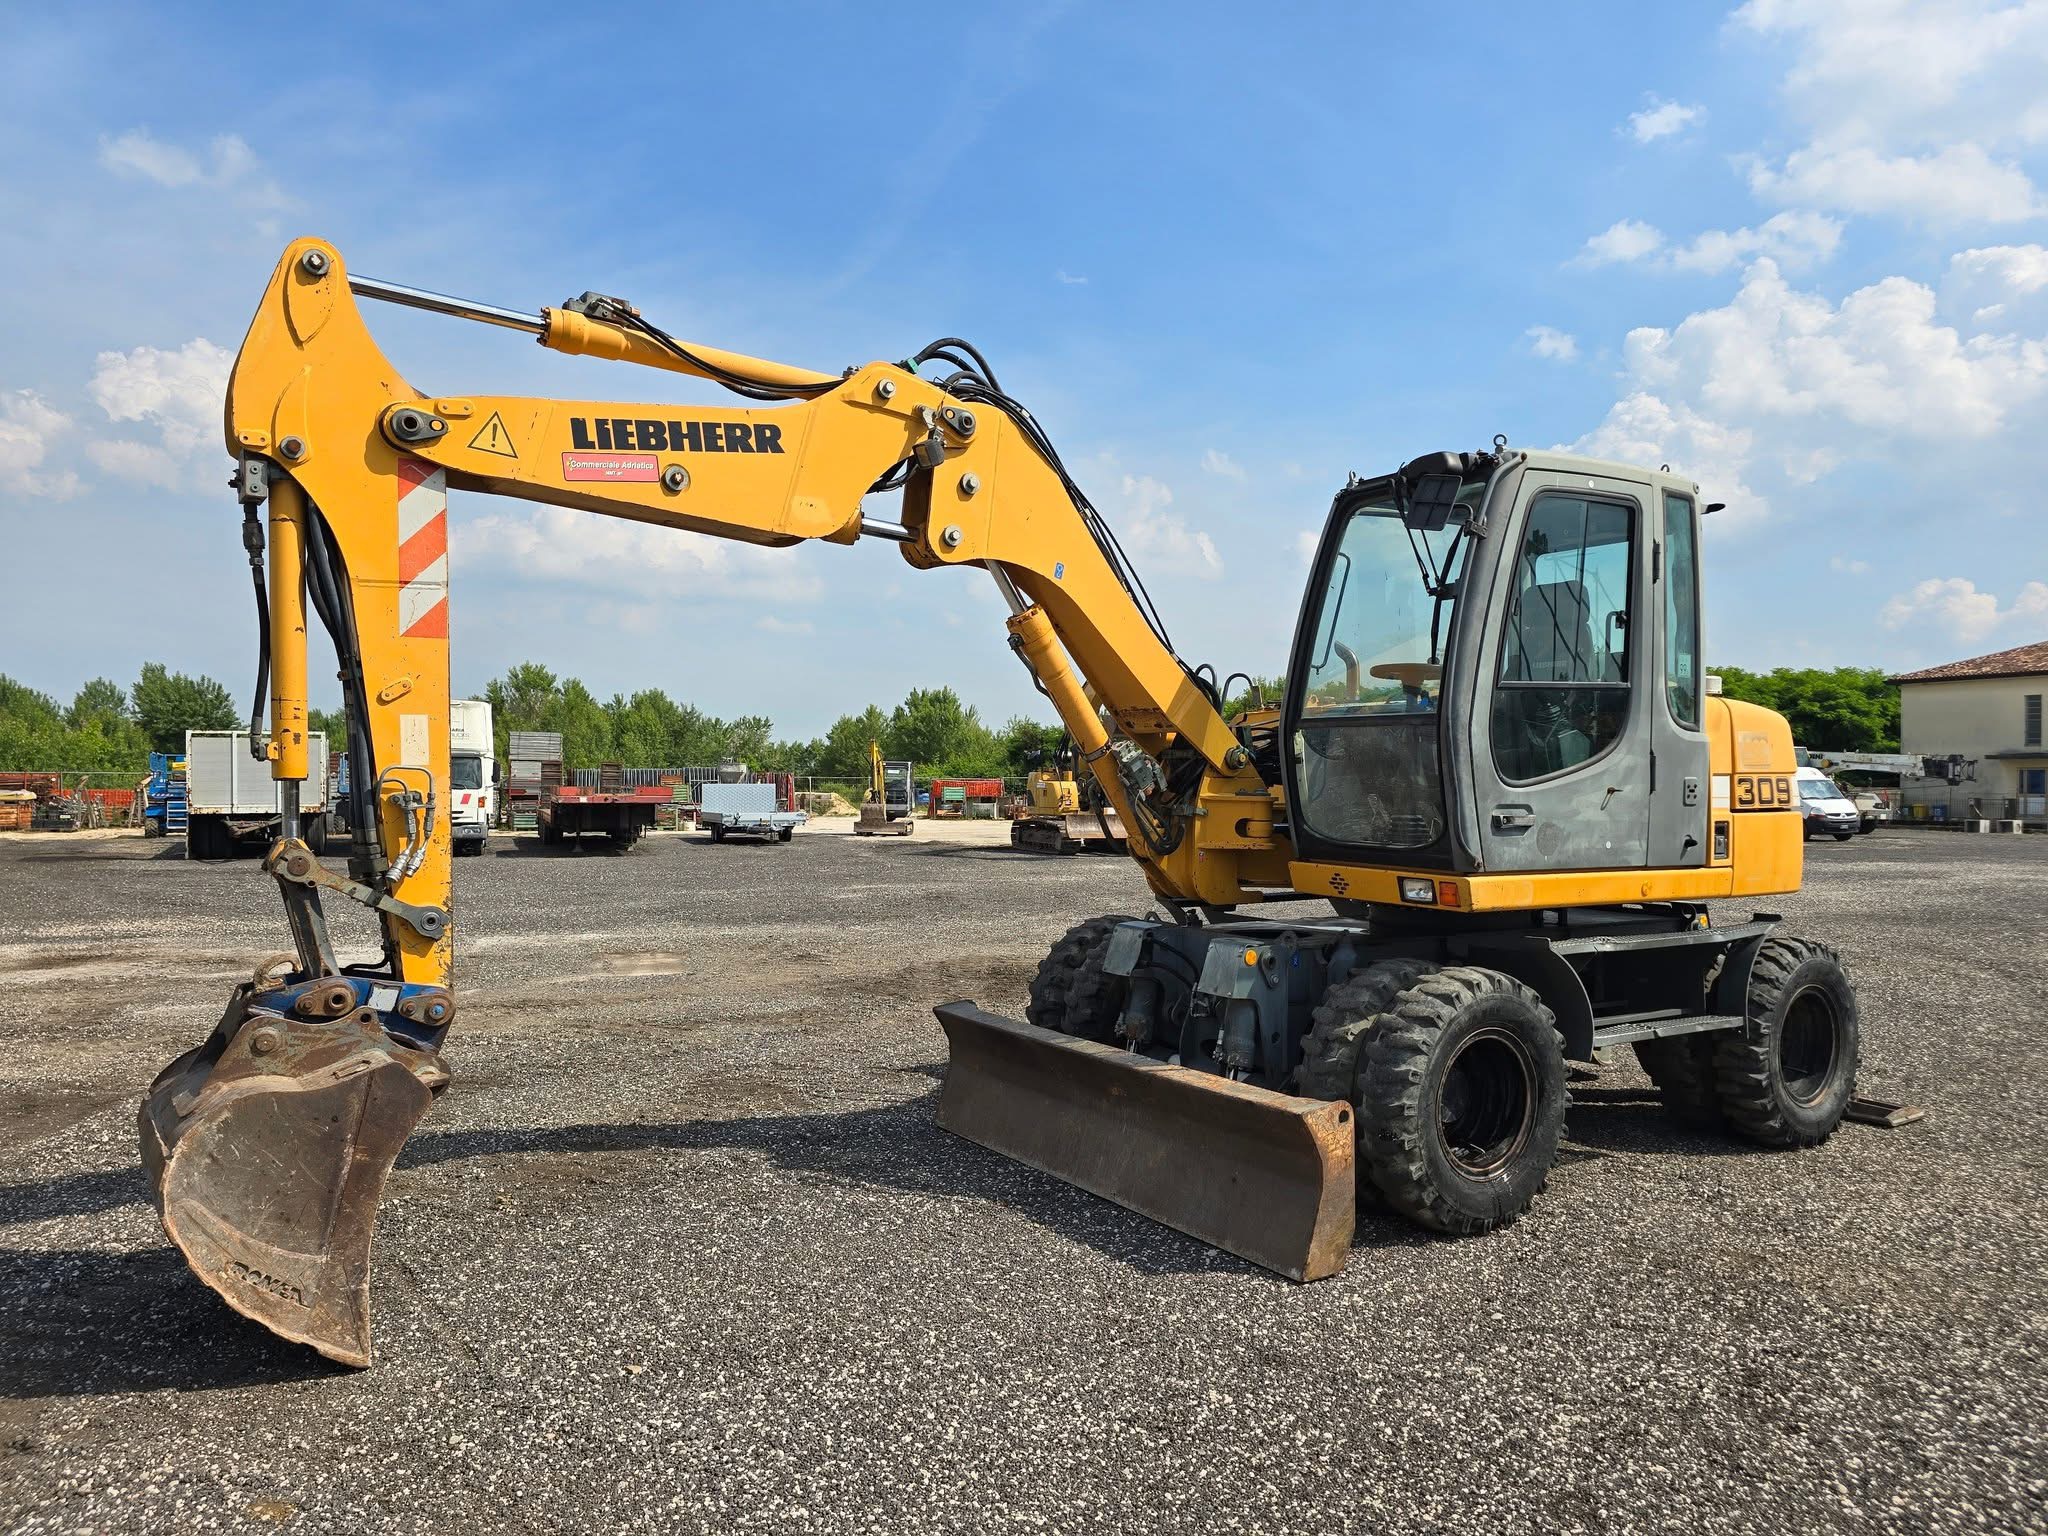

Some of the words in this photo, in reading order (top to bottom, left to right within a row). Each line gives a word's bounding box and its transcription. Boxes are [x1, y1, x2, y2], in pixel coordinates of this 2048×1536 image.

[570, 417, 785, 453] LIEBHERR
[571, 460, 620, 469] Commerciale
[621, 461, 654, 470] Adriatica
[1737, 776, 1791, 806] 309
